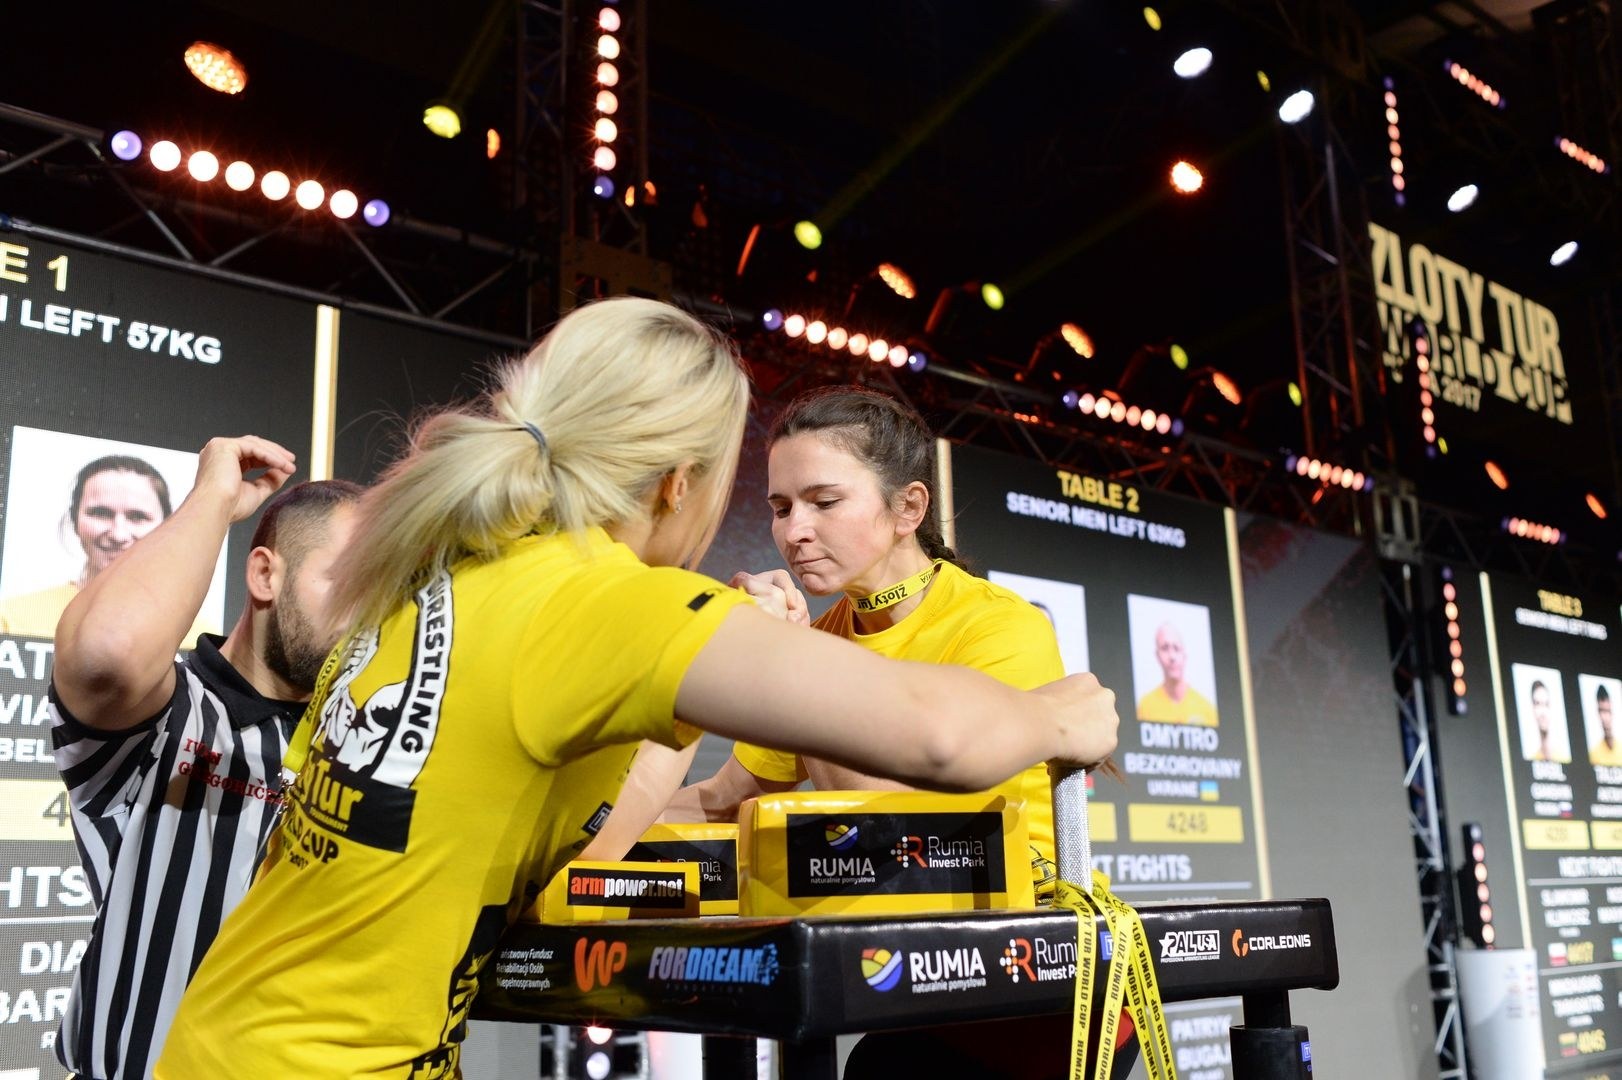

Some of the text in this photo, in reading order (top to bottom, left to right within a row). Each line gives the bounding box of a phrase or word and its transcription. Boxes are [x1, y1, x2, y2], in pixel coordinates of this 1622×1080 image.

[48, 255, 68, 292] 1
[20, 299, 120, 343] LEFT
[126, 321, 222, 364] 57KG
[1488, 280, 1566, 380] TUR
[1057, 470, 1140, 514] TABLE 2
[1006, 491, 1071, 525] SENIOR
[1072, 506, 1108, 533] MEN
[1109, 513, 1146, 541] LEFT
[1140, 722, 1219, 752] DMYTRO
[301, 828, 339, 864] CUP
[928, 835, 985, 856] Rumia
[809, 857, 875, 877] RUMIA
[929, 857, 985, 868] Invest Park
[1116, 855, 1192, 882] FIGHTS
[570, 874, 684, 900] armpower.net
[702, 873, 722, 882] Park
[1034, 935, 1078, 965] Rumi
[1083, 931, 1092, 954] TUR
[1117, 930, 1128, 959] 2017
[1196, 934, 1218, 951] USA
[1248, 934, 1311, 951] CORLEONIS
[909, 948, 987, 982] RUMIA
[1037, 965, 1068, 982] Invest
[1080, 957, 1092, 1000] WORLD
[1138, 950, 1153, 990] RUMIA
[911, 981, 949, 994] naturalnie
[1111, 961, 1124, 1001] RUMIA
[1079, 1004, 1088, 1029] CUP
[1106, 1010, 1117, 1035] CUP
[1127, 964, 1158, 1080] WORLD CUP RUMIA
[1150, 999, 1162, 1020] CUP
[1157, 1024, 1171, 1066] WORLD
